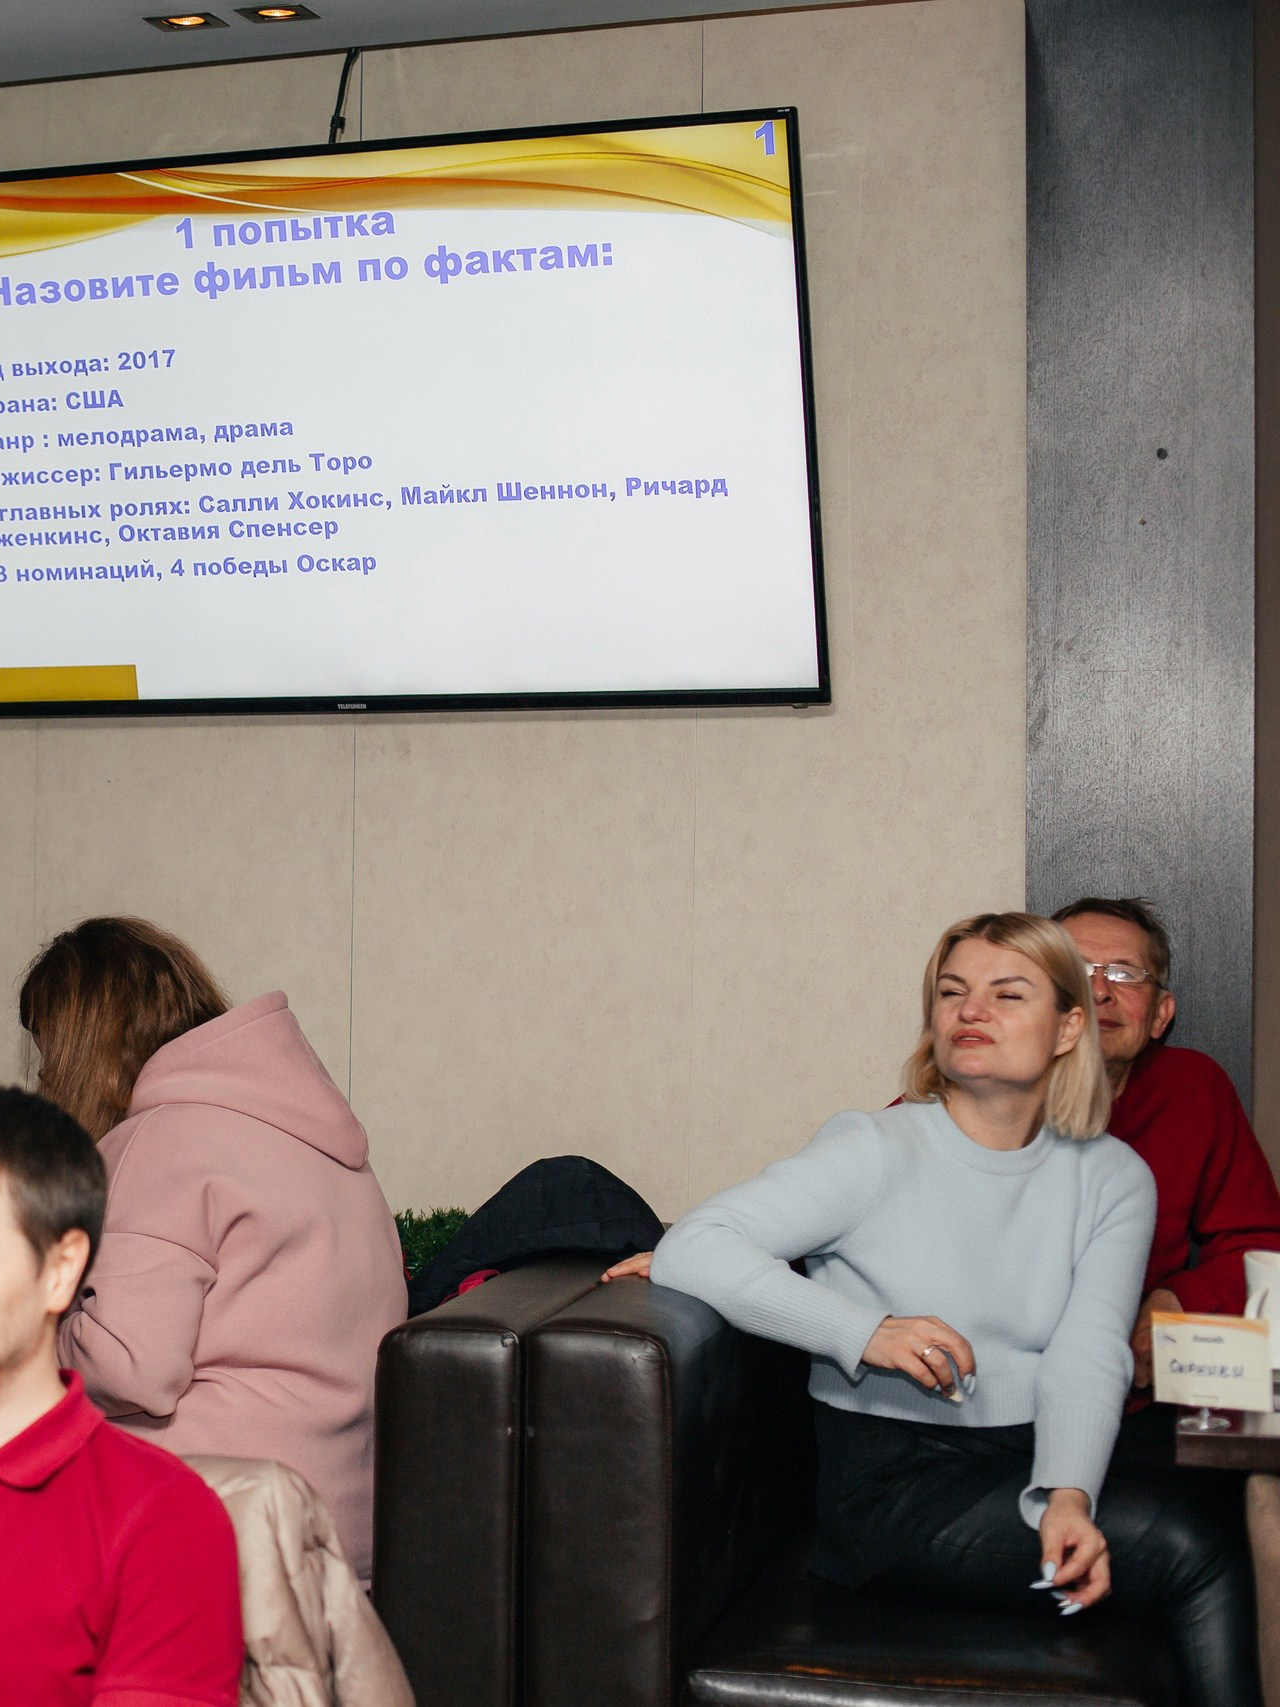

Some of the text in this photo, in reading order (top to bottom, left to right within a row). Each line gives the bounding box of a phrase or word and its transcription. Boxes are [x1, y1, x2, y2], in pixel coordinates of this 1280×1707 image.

[755, 121, 775, 155] 1
[176, 210, 395, 250] 1 попытка
[194, 260, 342, 300] фильм
[358, 255, 409, 282] по
[424, 241, 614, 285] фактам:
[11, 357, 110, 378] выхода:
[118, 348, 177, 372] 2017
[66, 388, 125, 411] США
[57, 425, 206, 448] мелодрама,
[214, 421, 294, 444] драма
[109, 461, 233, 482] Гильермо
[241, 458, 302, 479] дель
[310, 453, 373, 475] Торо
[0, 503, 101, 522] главных
[110, 499, 191, 523] ролях:
[199, 495, 279, 514] Салли
[288, 490, 392, 510] Хокинс,
[401, 485, 488, 505] Майкл
[497, 481, 617, 502] Шеннон,
[626, 476, 729, 499] Ричард
[119, 523, 220, 543] Октавия
[229, 519, 339, 540] Спенсер
[16, 563, 163, 583] номинаций,
[170, 559, 185, 577] 4
[193, 556, 288, 578] победы
[297, 553, 377, 576] Оскар
